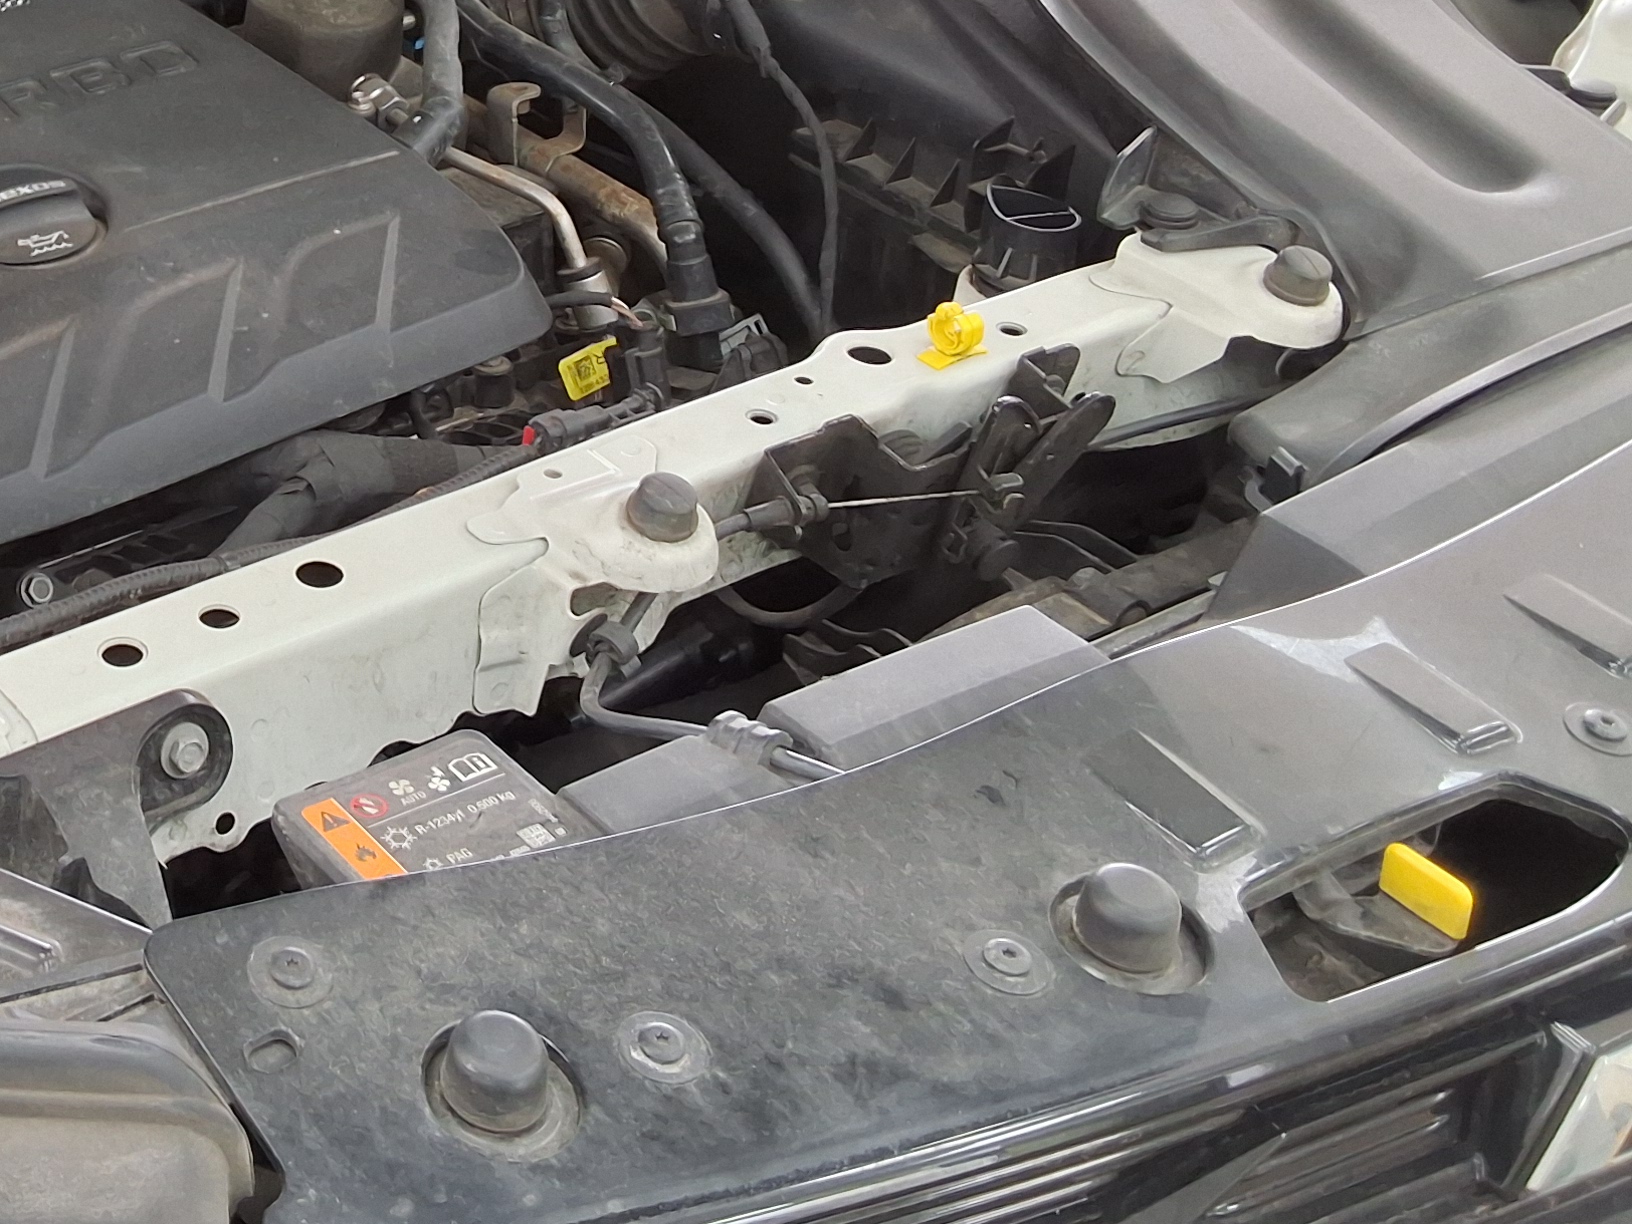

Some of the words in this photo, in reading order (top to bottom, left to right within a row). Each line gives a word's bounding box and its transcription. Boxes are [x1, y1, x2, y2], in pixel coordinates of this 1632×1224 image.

[400, 790, 427, 806] AUTO
[496, 790, 516, 802] kg
[445, 847, 473, 864] PAG
